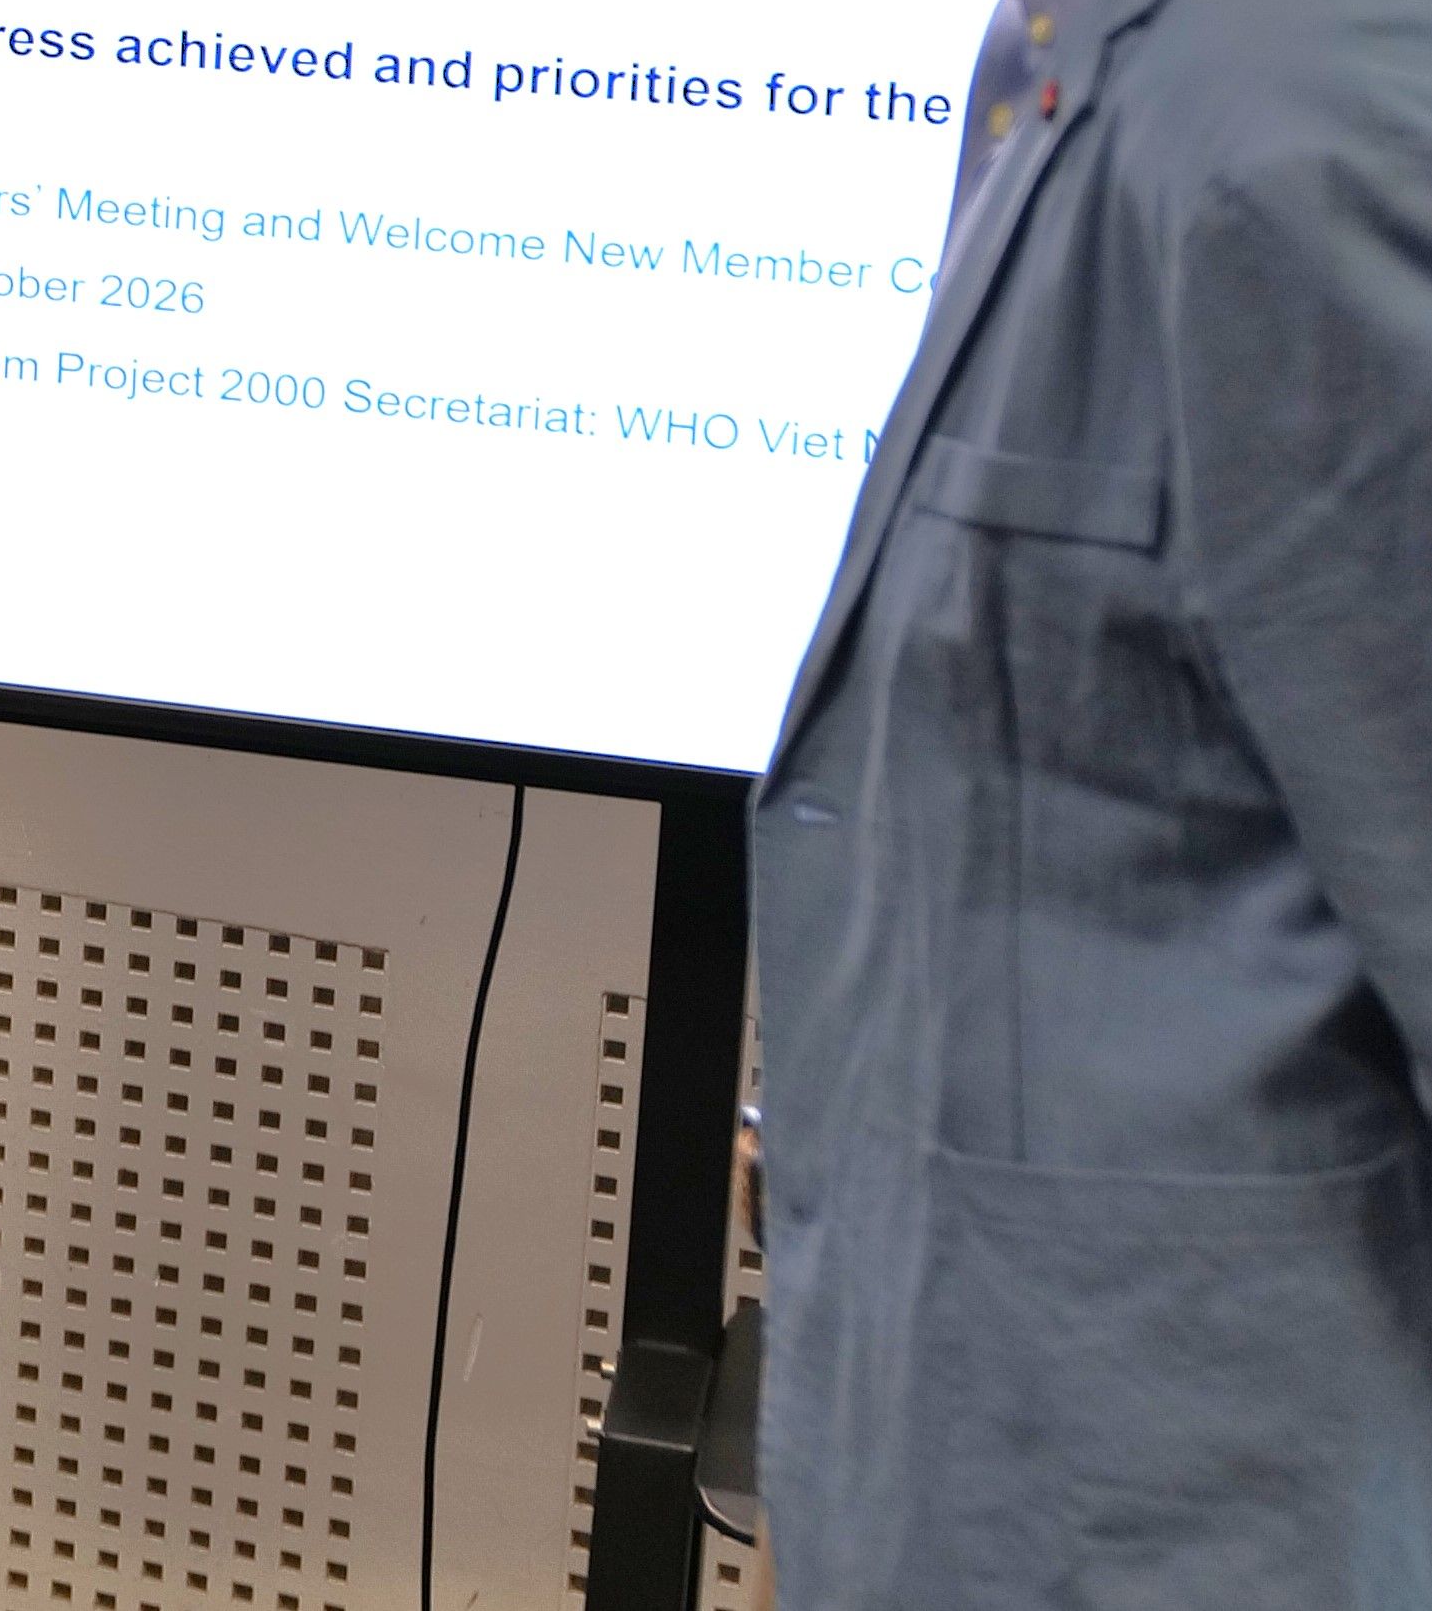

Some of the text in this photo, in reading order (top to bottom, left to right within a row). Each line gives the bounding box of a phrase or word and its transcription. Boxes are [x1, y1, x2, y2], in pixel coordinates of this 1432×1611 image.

[116, 30, 353, 79] achieved
[375, 51, 471, 88] and
[494, 57, 742, 109] priorities
[765, 72, 844, 116] for
[865, 82, 951, 124] the
[58, 187, 225, 242] Meeting
[243, 209, 321, 241] and
[340, 211, 545, 260] Welcome
[565, 230, 663, 270] New
[683, 239, 871, 288] Member
[889, 256, 938, 294] C
[100, 274, 203, 313] 2026
[57, 352, 204, 400] Project
[220, 369, 325, 408] 2000
[344, 379, 595, 436] Secretariat:
[617, 405, 739, 449] WHO
[759, 419, 844, 460] Viet
